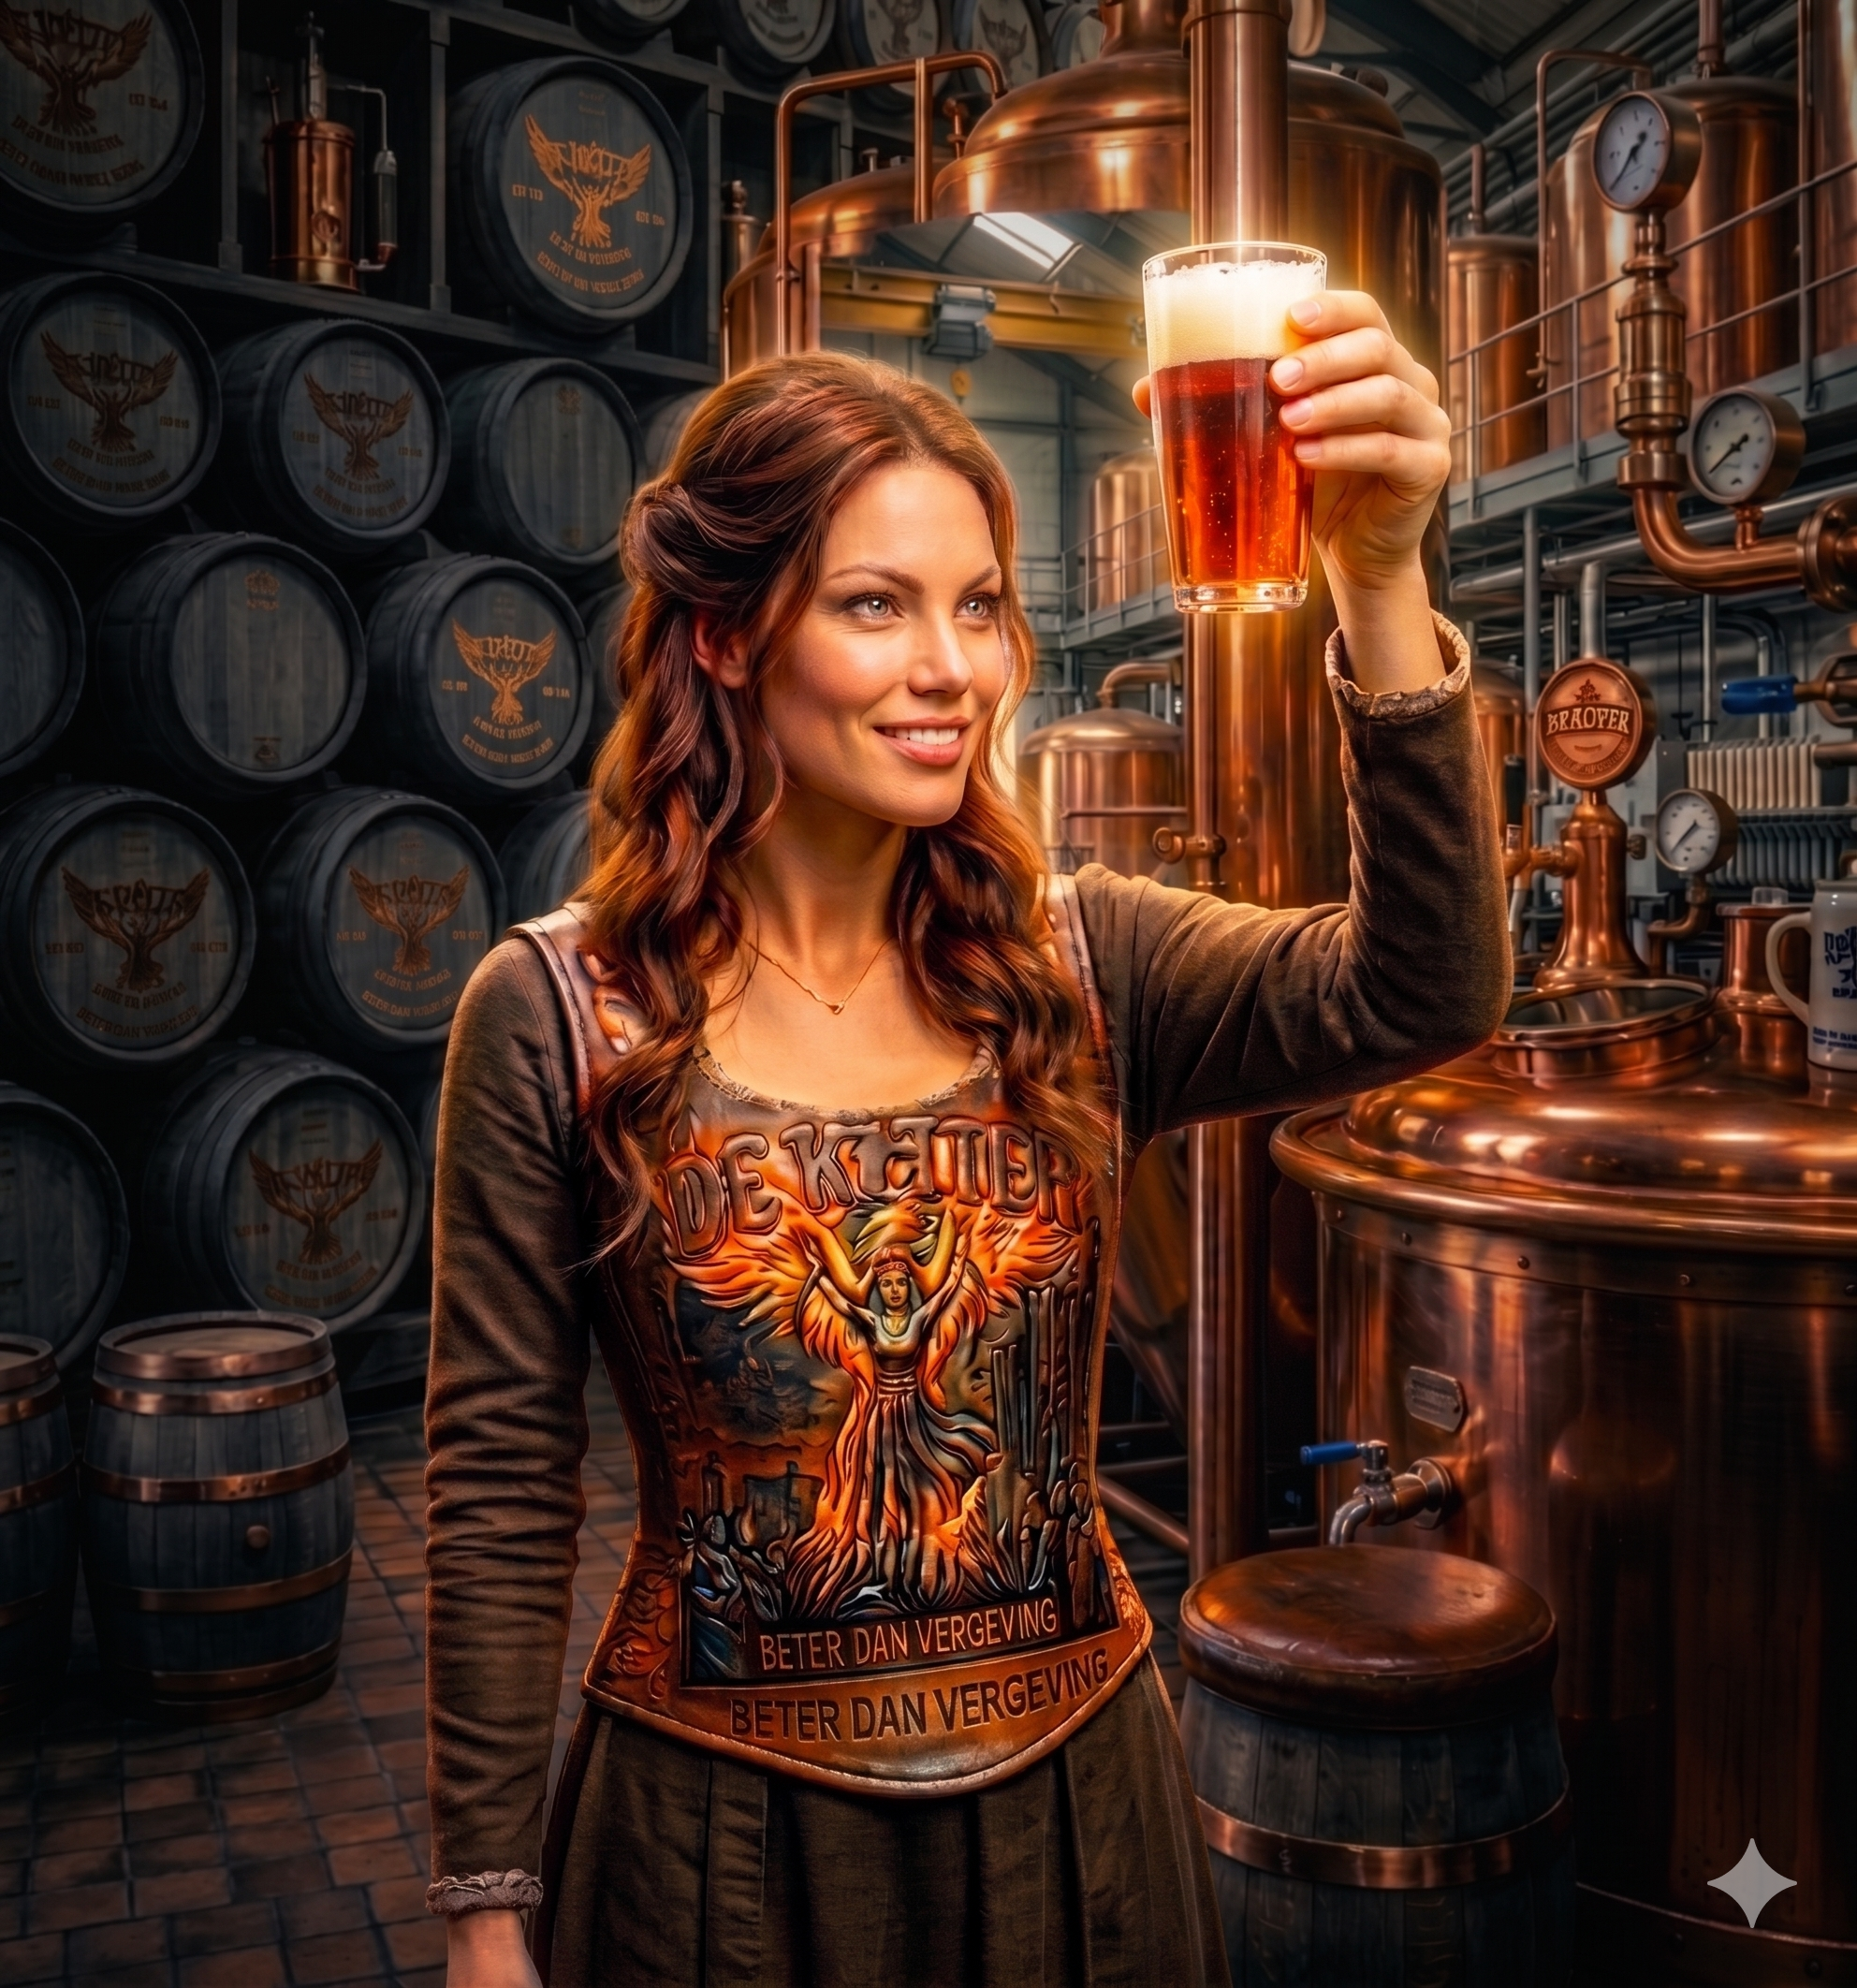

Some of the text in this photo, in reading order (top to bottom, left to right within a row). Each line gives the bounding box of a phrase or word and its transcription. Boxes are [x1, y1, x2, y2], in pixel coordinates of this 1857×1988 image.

[664, 1132, 783, 1259] DE
[759, 1597, 1058, 1671] BETER DAN VERGEVING
[729, 1647, 1109, 1743] BETER DAN VERGEVING
